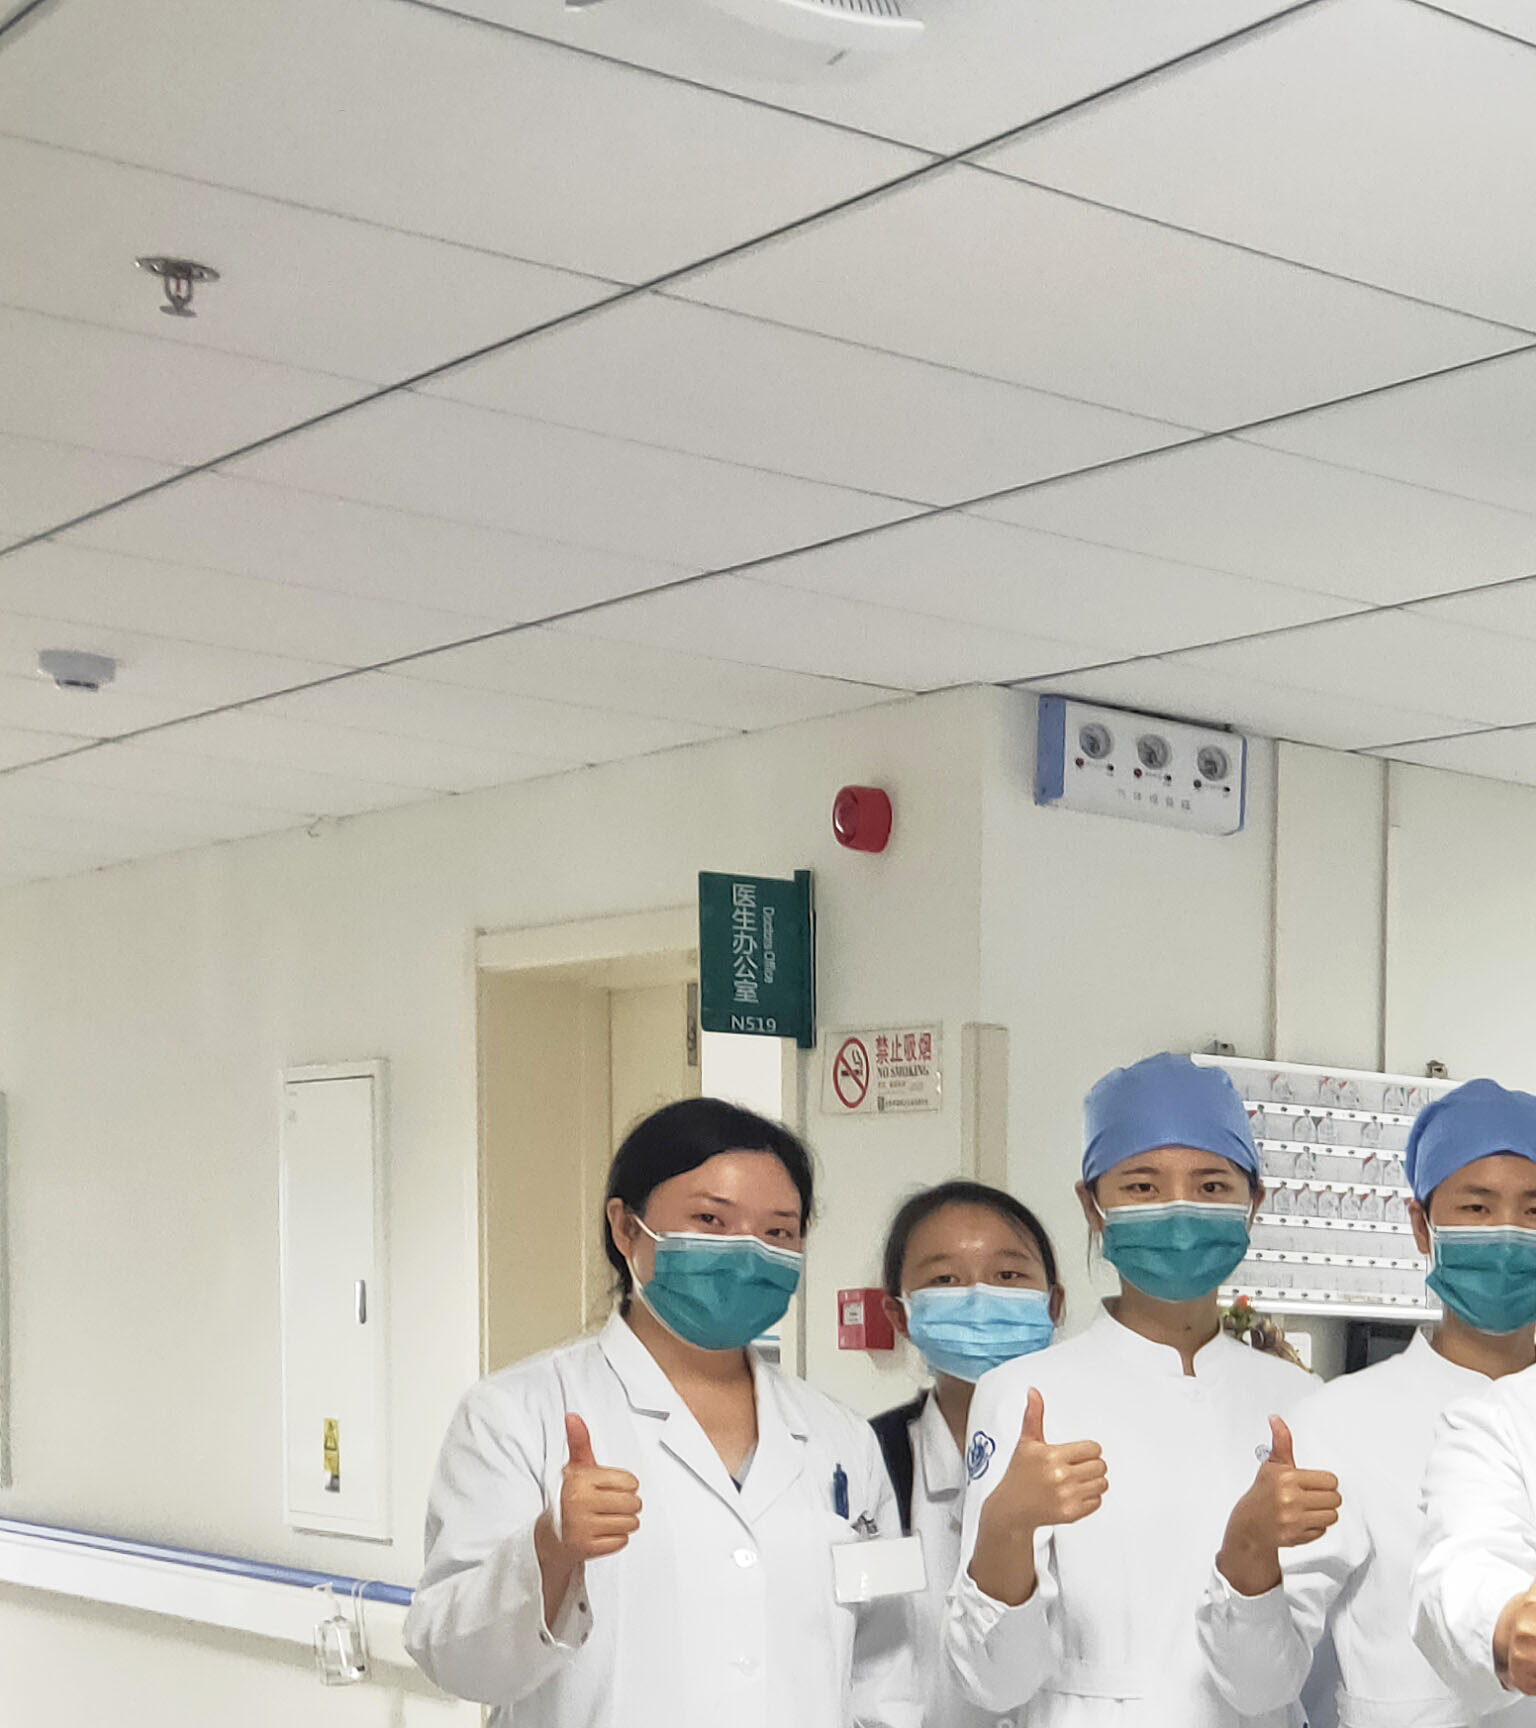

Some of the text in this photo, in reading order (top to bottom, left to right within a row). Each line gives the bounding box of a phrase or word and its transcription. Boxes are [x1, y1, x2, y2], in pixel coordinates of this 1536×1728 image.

[731, 882, 760, 1004] 医生办公室
[763, 951, 777, 984] Office
[730, 1014, 777, 1033] N519
[875, 1032, 932, 1064] 禁止吸烟
[876, 1066, 889, 1079] NO
